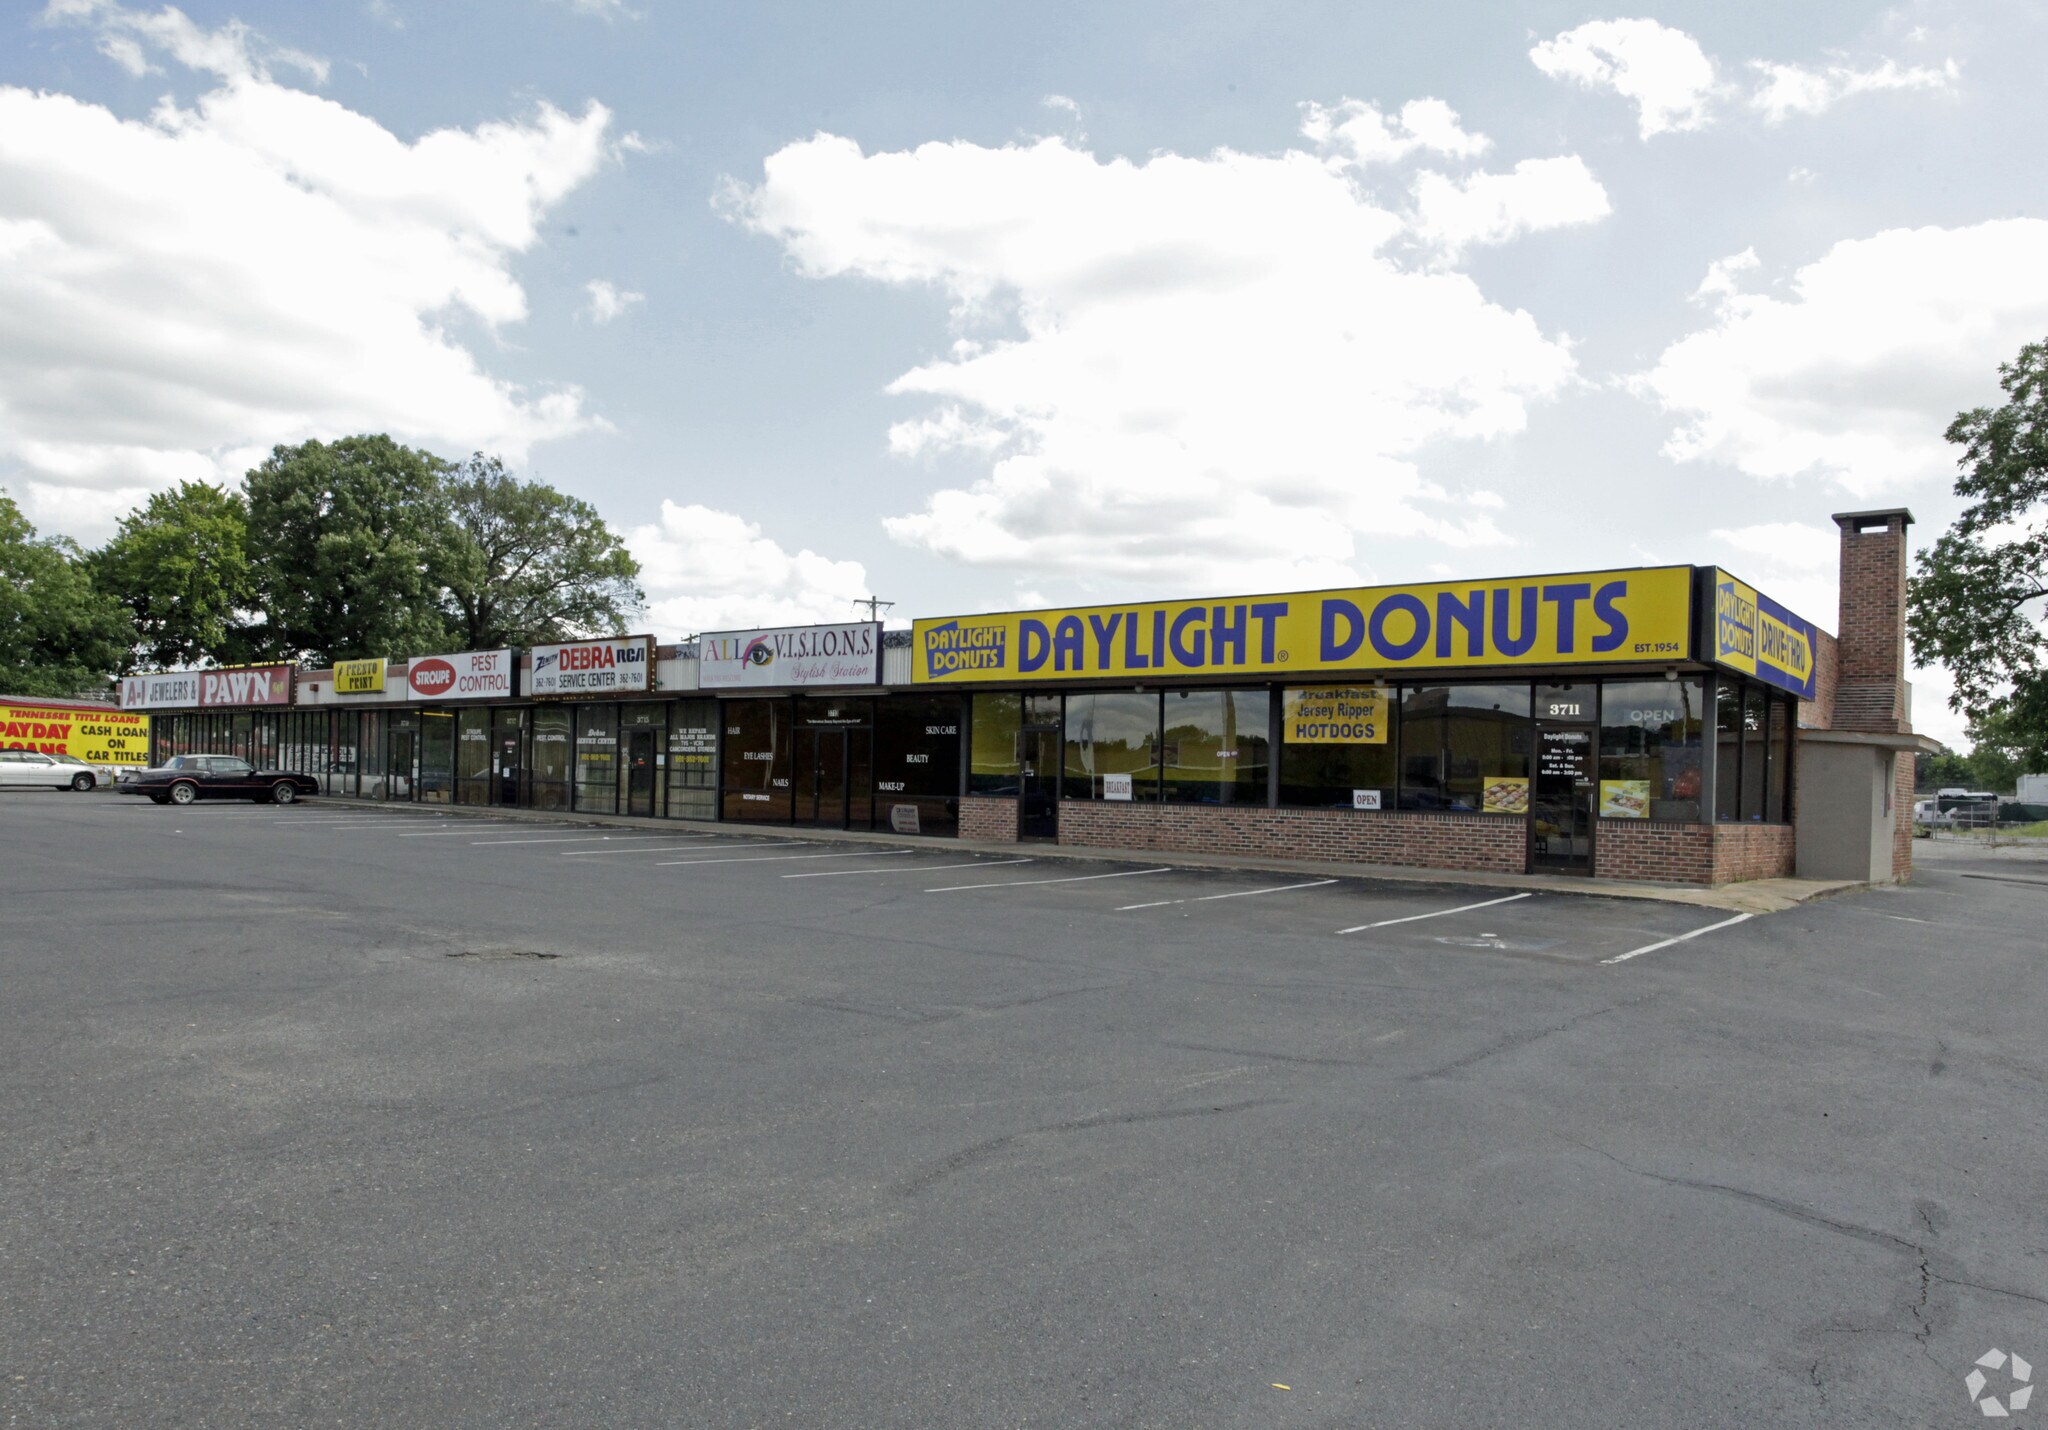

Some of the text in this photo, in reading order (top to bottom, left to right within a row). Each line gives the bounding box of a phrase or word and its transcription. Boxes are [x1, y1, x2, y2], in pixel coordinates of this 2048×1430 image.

[1719, 588, 1755, 630] DAYLIGHT
[1018, 581, 1629, 673] DAYLIGHT DONUTS
[927, 626, 1005, 650] DAYLIGHT
[1721, 619, 1753, 656] DONUTS
[704, 638, 744, 661] ALL
[1761, 618, 1806, 673] DRIVE-THRU
[560, 645, 616, 671] DEBRA
[616, 647, 645, 663] RCA
[933, 649, 999, 670] DONUTS
[346, 663, 377, 675] PRESTO
[472, 655, 498, 671] PEST
[416, 670, 450, 685] STROUPE
[619, 672, 643, 683] 362-7601
[792, 661, 869, 683] Stylish Station
[349, 677, 373, 689] PRINT
[459, 674, 509, 692] CONTROL
[559, 672, 616, 688] SERVICE CENTER
[150, 681, 188, 701] JEWELERS
[191, 680, 196, 699] &
[204, 672, 271, 703] PAWN
[1298, 703, 1374, 719] Jersey Ripper
[1550, 704, 1580, 715] 3711
[1631, 710, 1674, 721] OPEN
[9, 710, 140, 724] TENNESSEE TITLE LOANS
[81, 725, 147, 737] CASH LOAN
[926, 726, 956, 734] SKIN CARE
[1296, 724, 1375, 738] HOTDOGS
[1544, 733, 1564, 741] Daylight
[108, 739, 125, 748] ON
[86, 751, 148, 761] CAR TITLES
[744, 752, 773, 760] EYE LASHES
[907, 755, 929, 763] BEAUTY
[879, 782, 905, 791] MAKE-UP
[1106, 781, 1130, 794] BREAKFAST
[1356, 795, 1377, 805] OPEN
